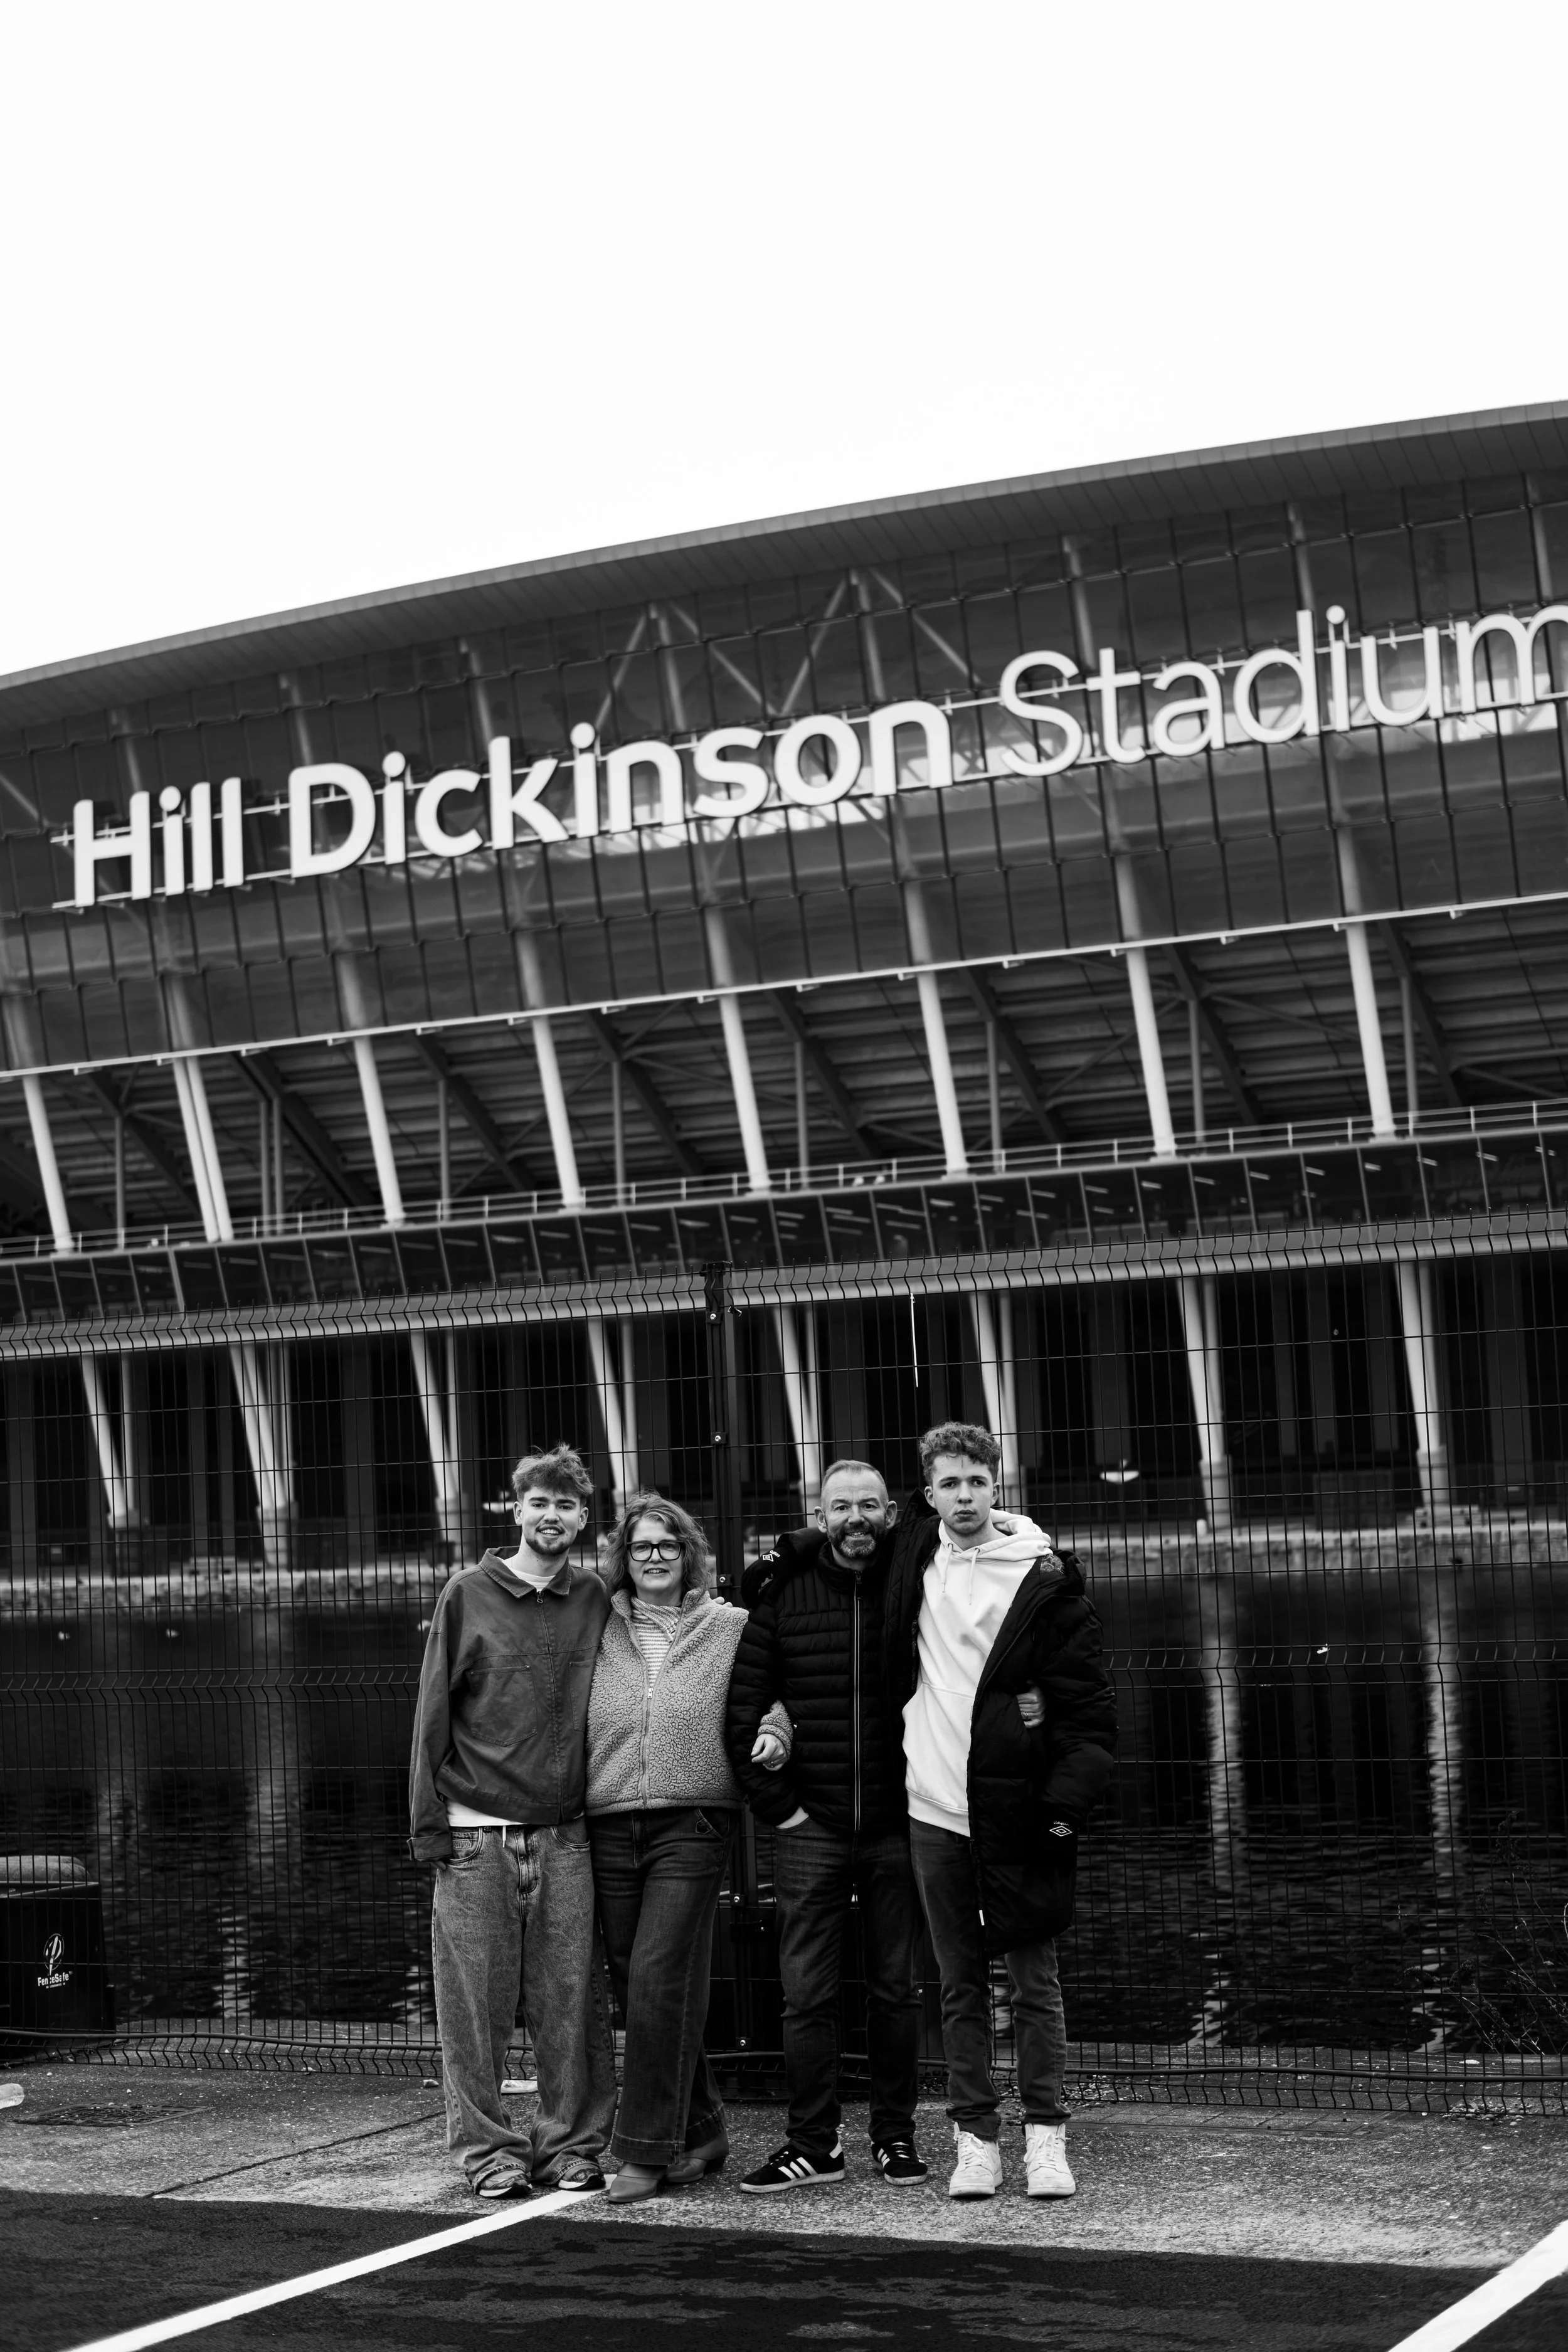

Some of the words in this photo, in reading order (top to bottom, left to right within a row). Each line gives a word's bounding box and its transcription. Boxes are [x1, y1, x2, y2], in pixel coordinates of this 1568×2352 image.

[73, 776, 243, 908] Hill
[289, 700, 953, 879] Dickinson
[1000, 605, 1568, 777] Stadium
